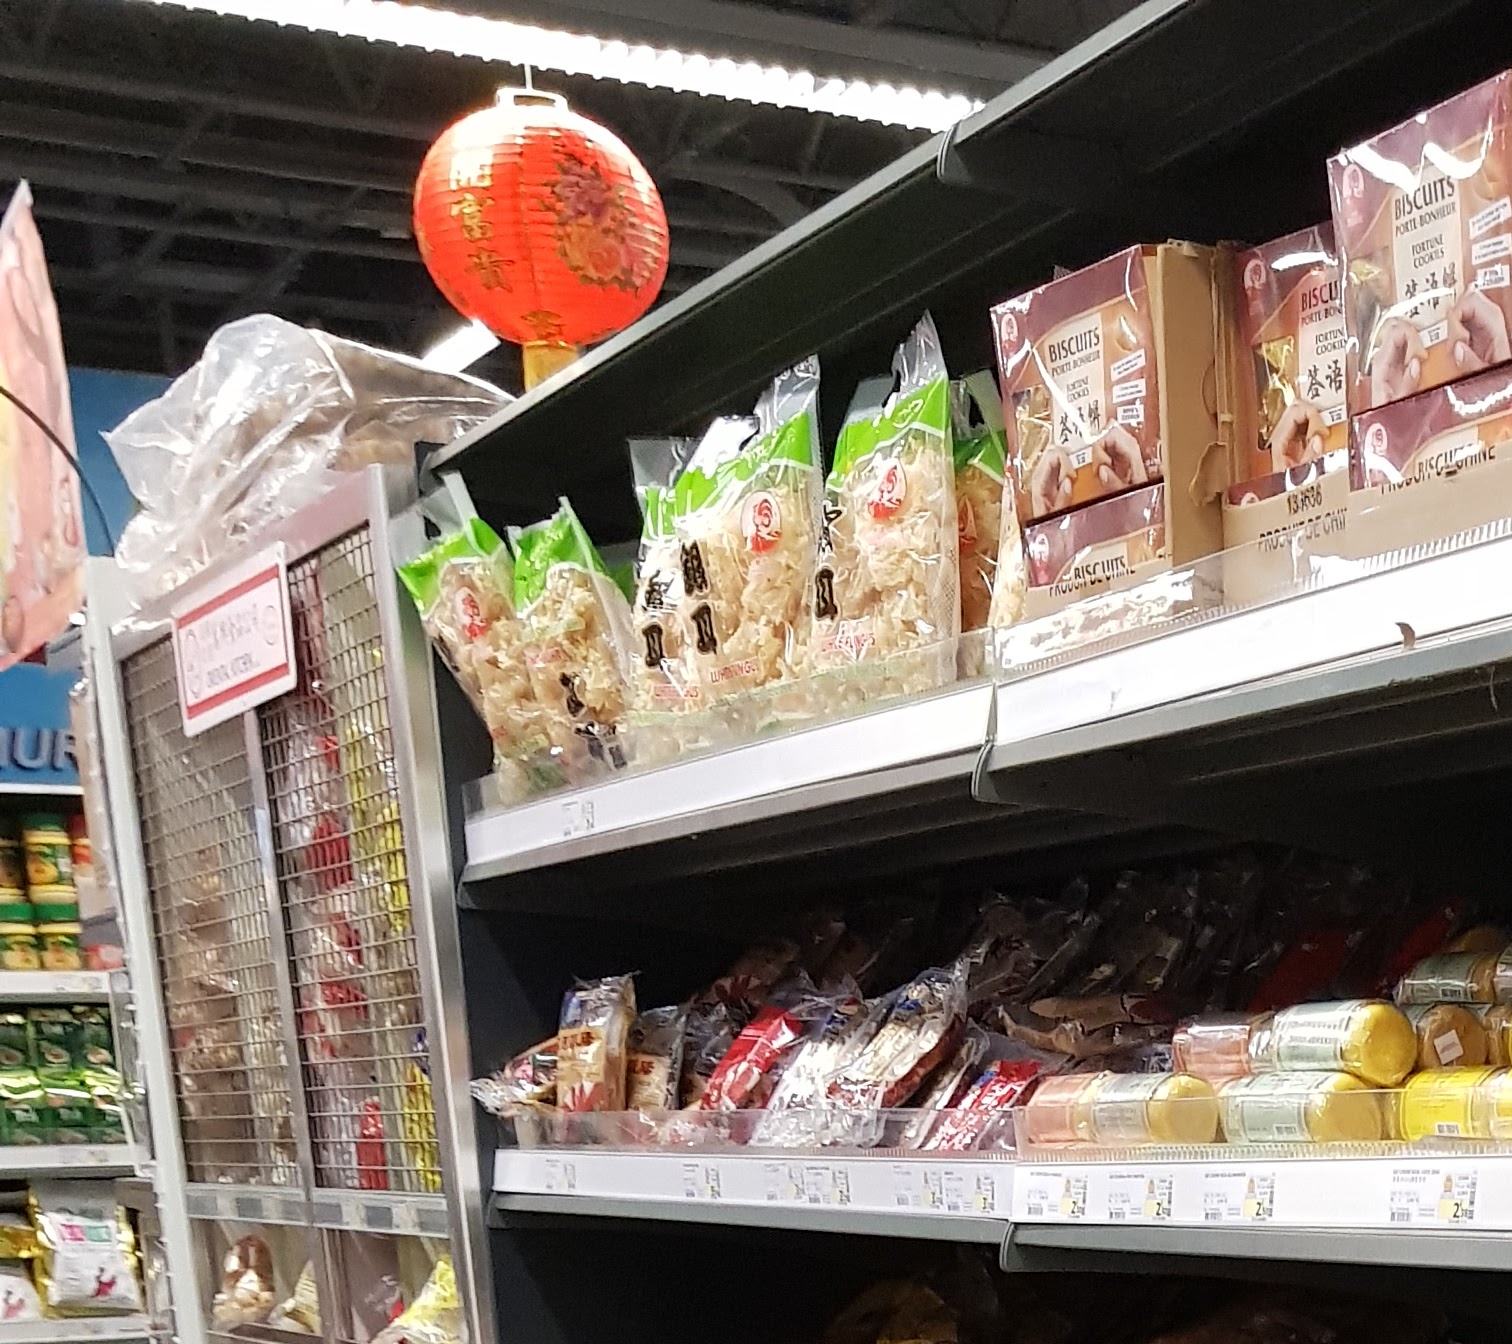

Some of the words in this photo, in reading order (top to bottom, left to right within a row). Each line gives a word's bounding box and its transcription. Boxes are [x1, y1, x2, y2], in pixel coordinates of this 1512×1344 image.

[1394, 176, 1455, 221] BISCUITS
[1395, 202, 1456, 237] PORTE-BONHEUR
[1412, 233, 1443, 257] FORTUNE
[1413, 249, 1444, 269] COOKIES
[1048, 327, 1100, 363] BISCUITS
[1073, 555, 1127, 580] BISCUITS
